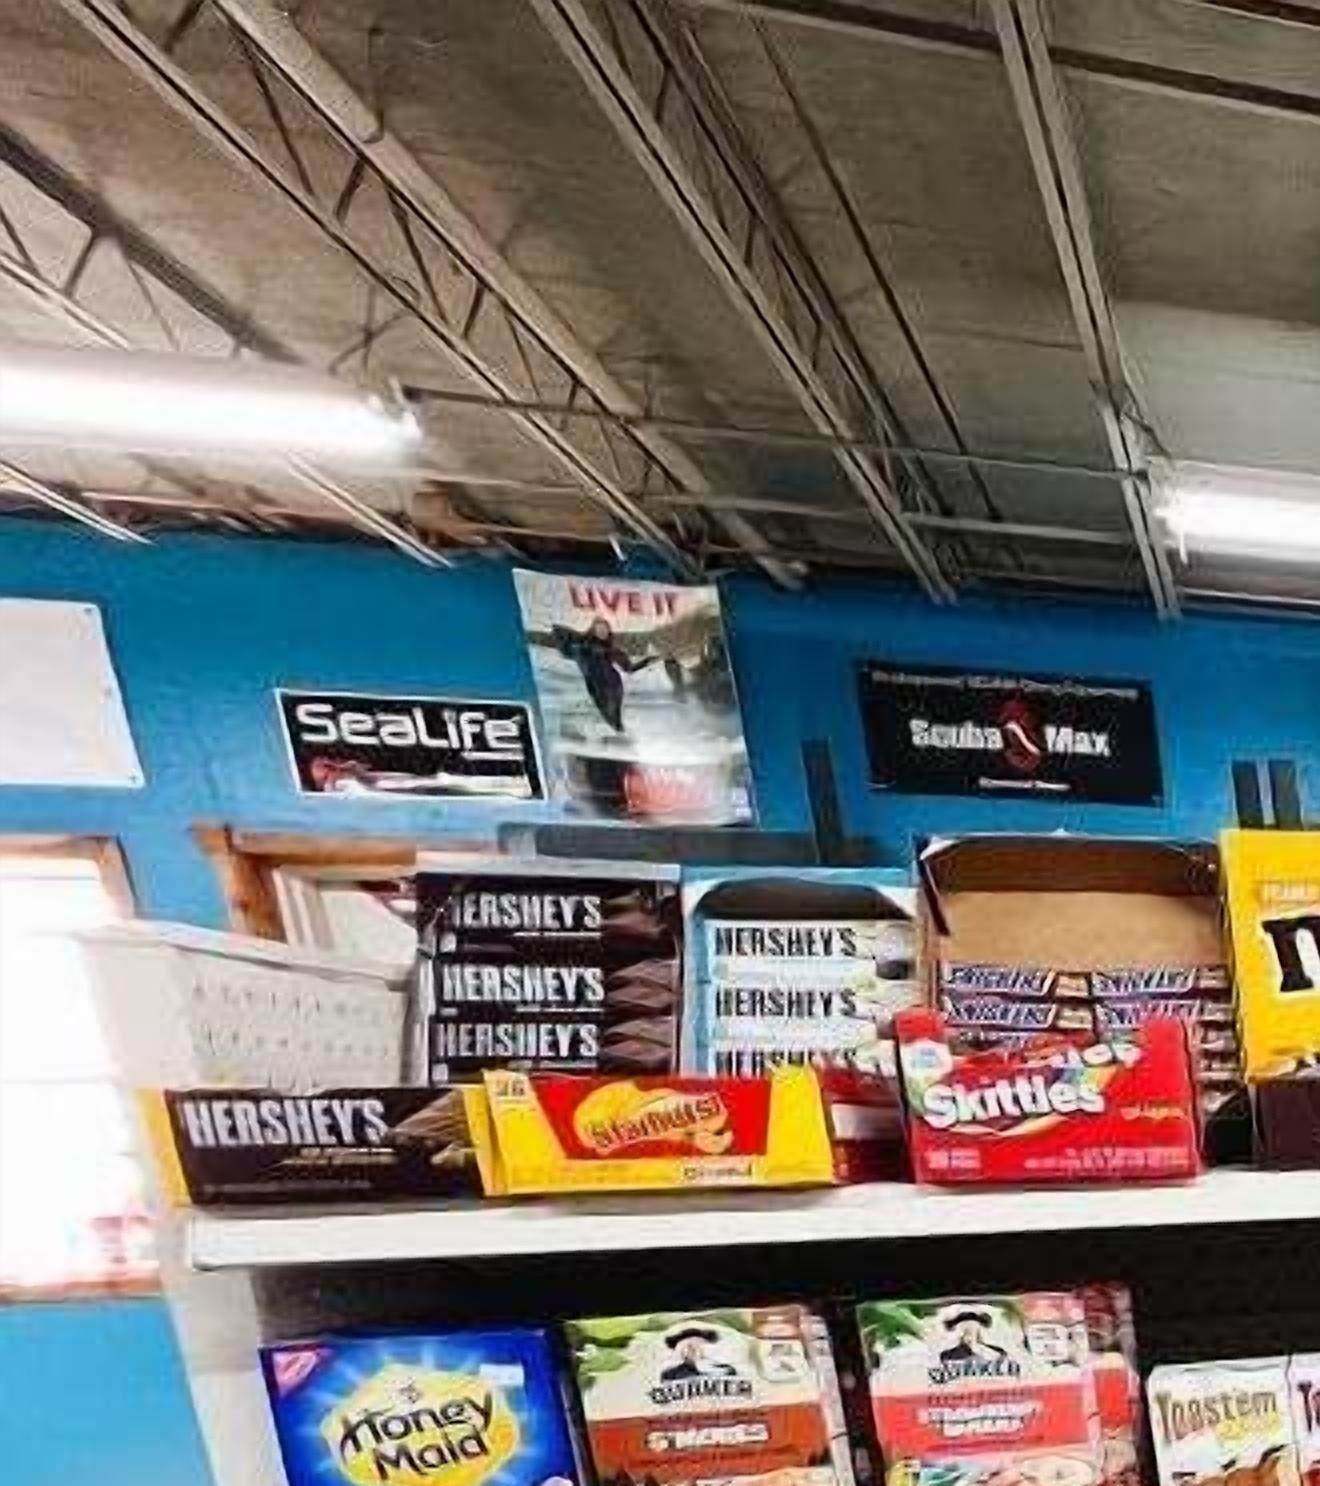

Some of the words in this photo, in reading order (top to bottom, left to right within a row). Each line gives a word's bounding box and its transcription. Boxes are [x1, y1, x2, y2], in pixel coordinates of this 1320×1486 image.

[570, 585, 643, 615] LIVE
[653, 591, 680, 617] IT
[909, 718, 1003, 754] Scuba
[1045, 727, 1111, 758] Max
[714, 927, 858, 959] HERSHEY'S
[440, 965, 604, 1004] HERSHEY'S
[714, 989, 858, 1019] HERSHEY'S
[435, 1023, 599, 1060] HERSHEY'S
[184, 1097, 387, 1148] HERSHEY'S
[921, 1075, 1106, 1131] Skittles
[648, 1379, 754, 1406] QUAKER
[340, 1390, 493, 1464] Honey
[371, 1428, 489, 1482] Maid
